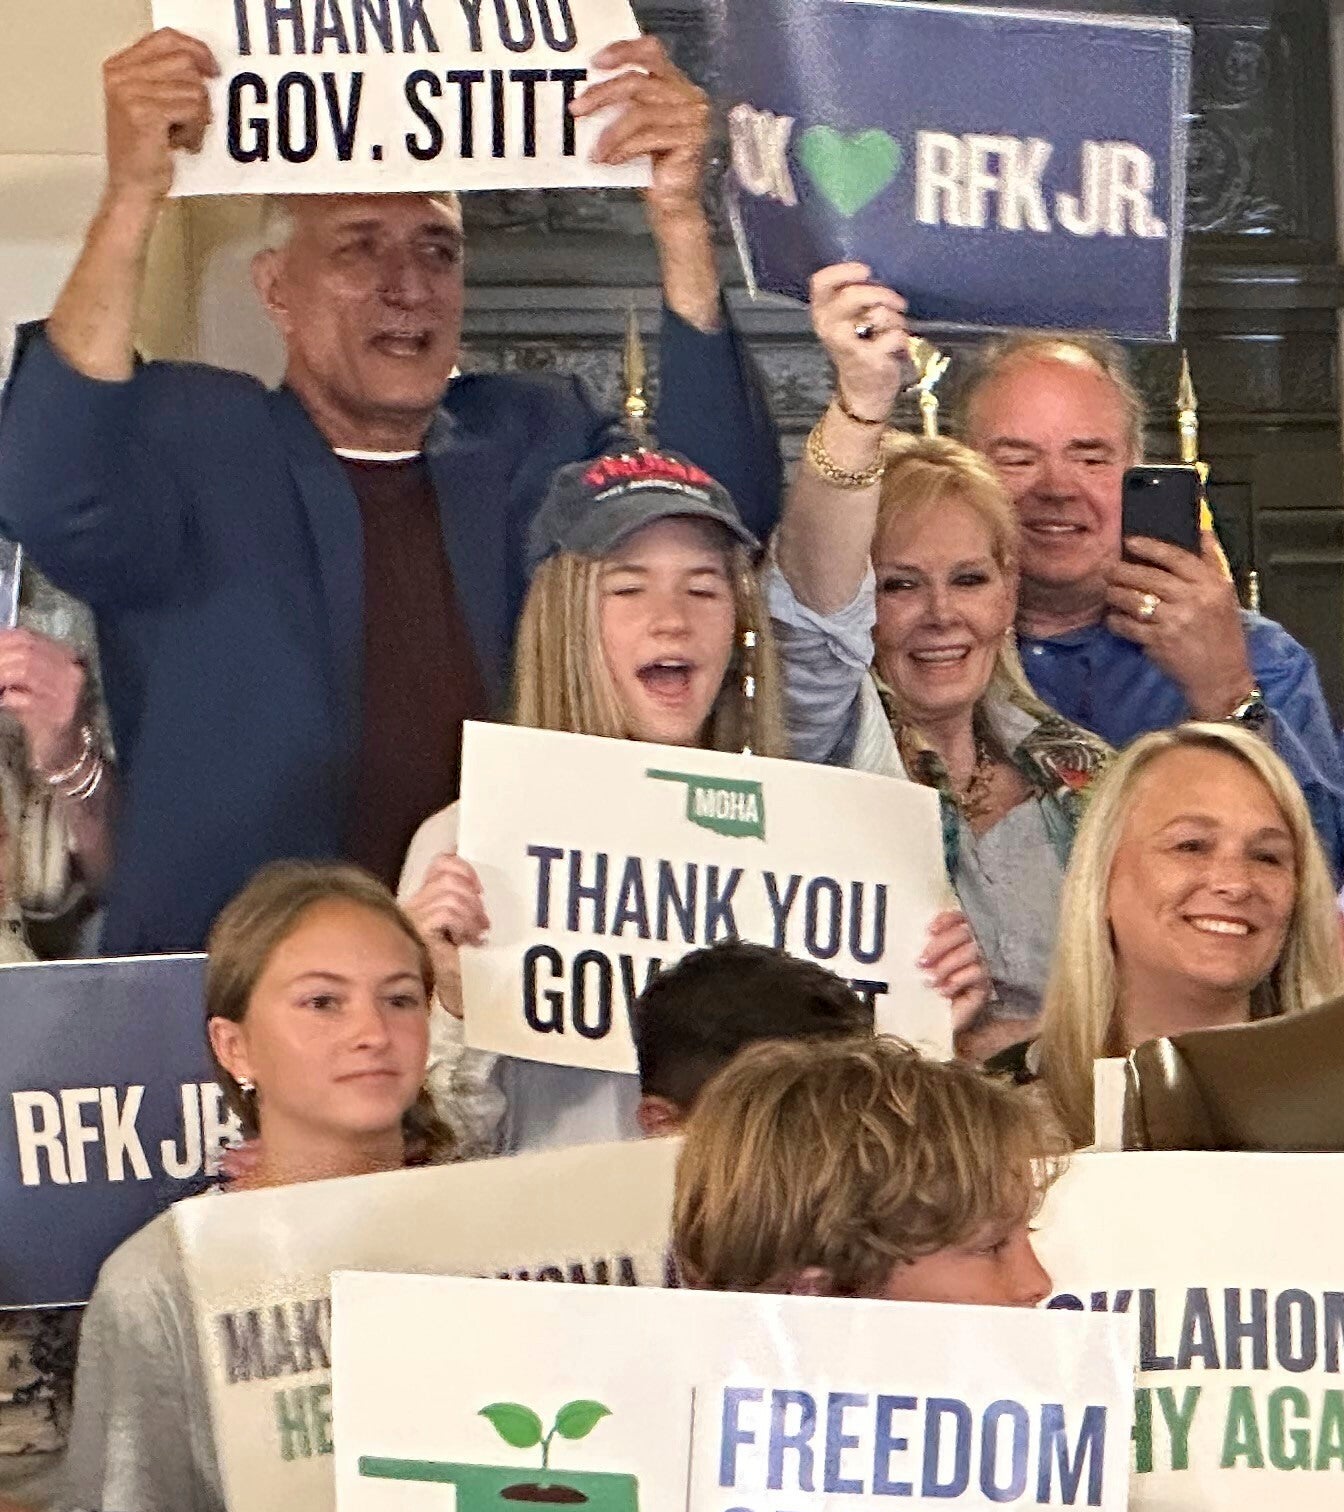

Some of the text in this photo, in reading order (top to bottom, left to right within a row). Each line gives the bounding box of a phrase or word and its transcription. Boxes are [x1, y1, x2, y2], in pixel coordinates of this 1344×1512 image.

[227, 68, 588, 162] GOV. STITT
[915, 130, 1052, 234] RFK
[694, 787, 760, 823] MOHA
[526, 844, 888, 965] THANK YOU
[12, 1085, 151, 1186] RFK
[718, 1385, 1107, 1506] FREEDOM
